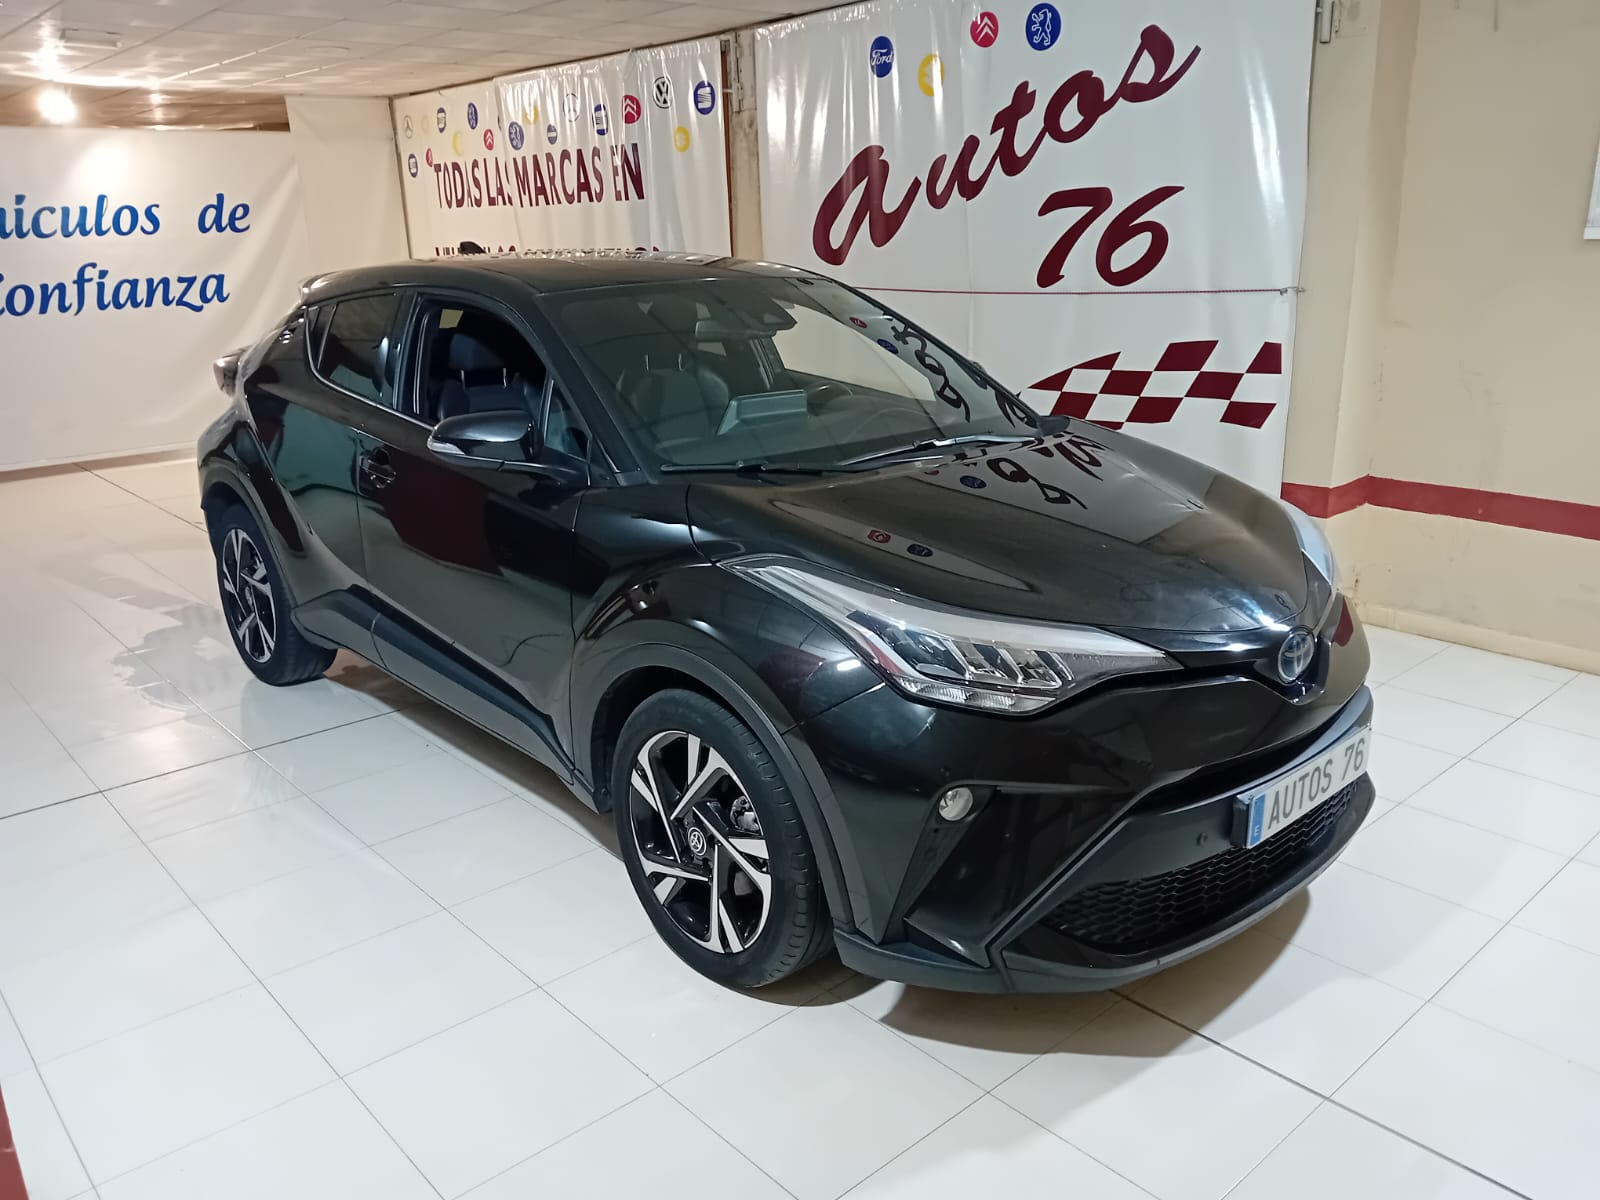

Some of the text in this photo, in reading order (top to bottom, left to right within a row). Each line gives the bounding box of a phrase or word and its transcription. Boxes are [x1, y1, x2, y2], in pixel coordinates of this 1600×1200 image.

[871, 48, 893, 66] Ford
[434, 159, 482, 208] TODAS
[513, 145, 604, 208] MARCAS
[610, 143, 645, 201] EN
[198, 193, 250, 233] de
[1036, 185, 1185, 289] 76
[0, 262, 230, 317] onfianza
[1268, 737, 1366, 830] AUTOS 76
